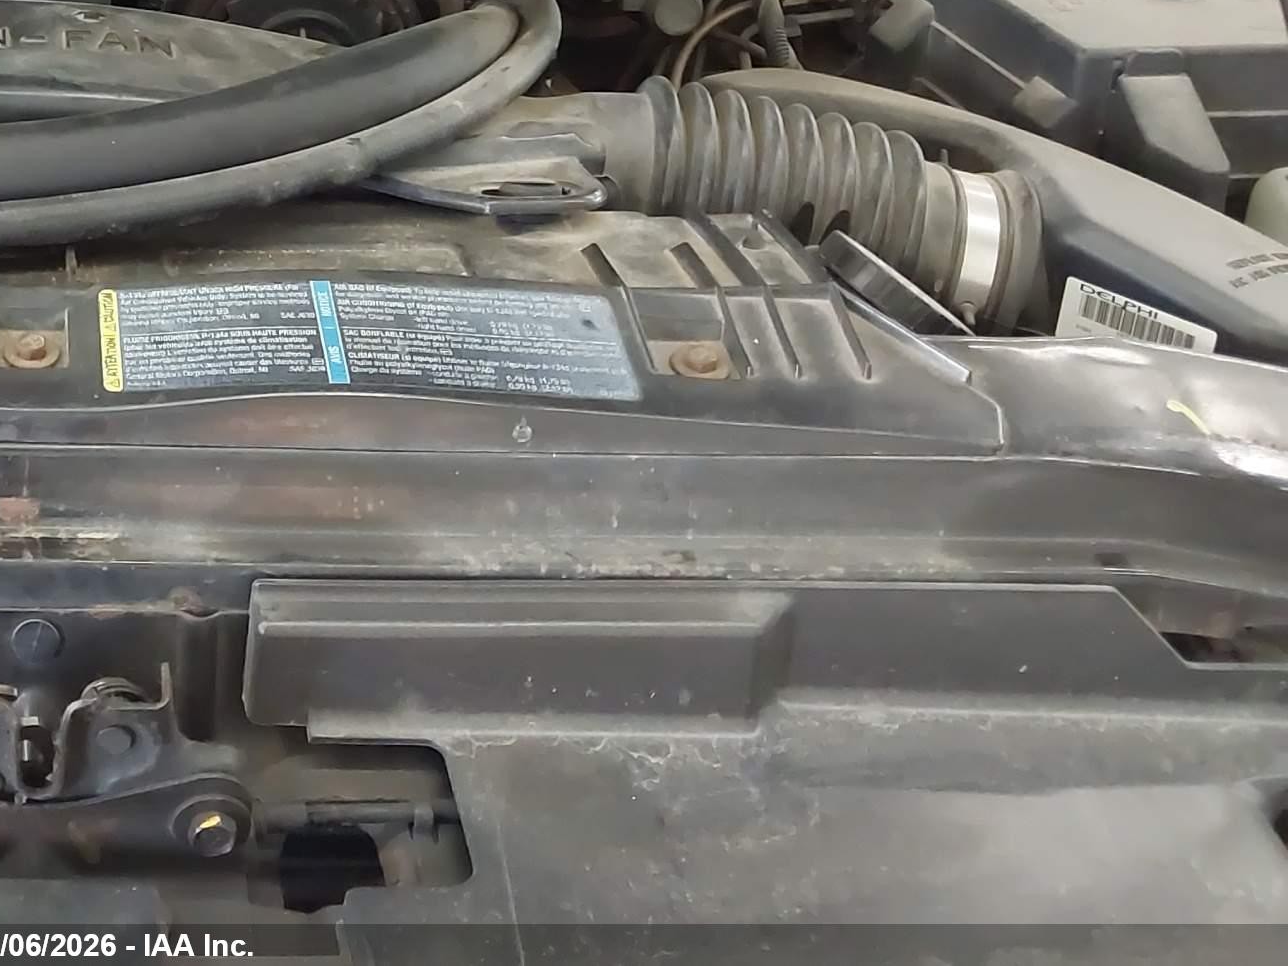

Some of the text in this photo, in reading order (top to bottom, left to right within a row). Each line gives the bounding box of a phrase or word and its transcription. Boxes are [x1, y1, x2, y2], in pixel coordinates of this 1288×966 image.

[317, 291, 333, 317] NOTICE
[1079, 283, 1160, 321] DELPHI
[252, 329, 279, 337] HAUTE
[343, 329, 359, 337] SAC
[327, 345, 344, 364] AVIS
[347, 352, 401, 361] CLIMATISEUR
